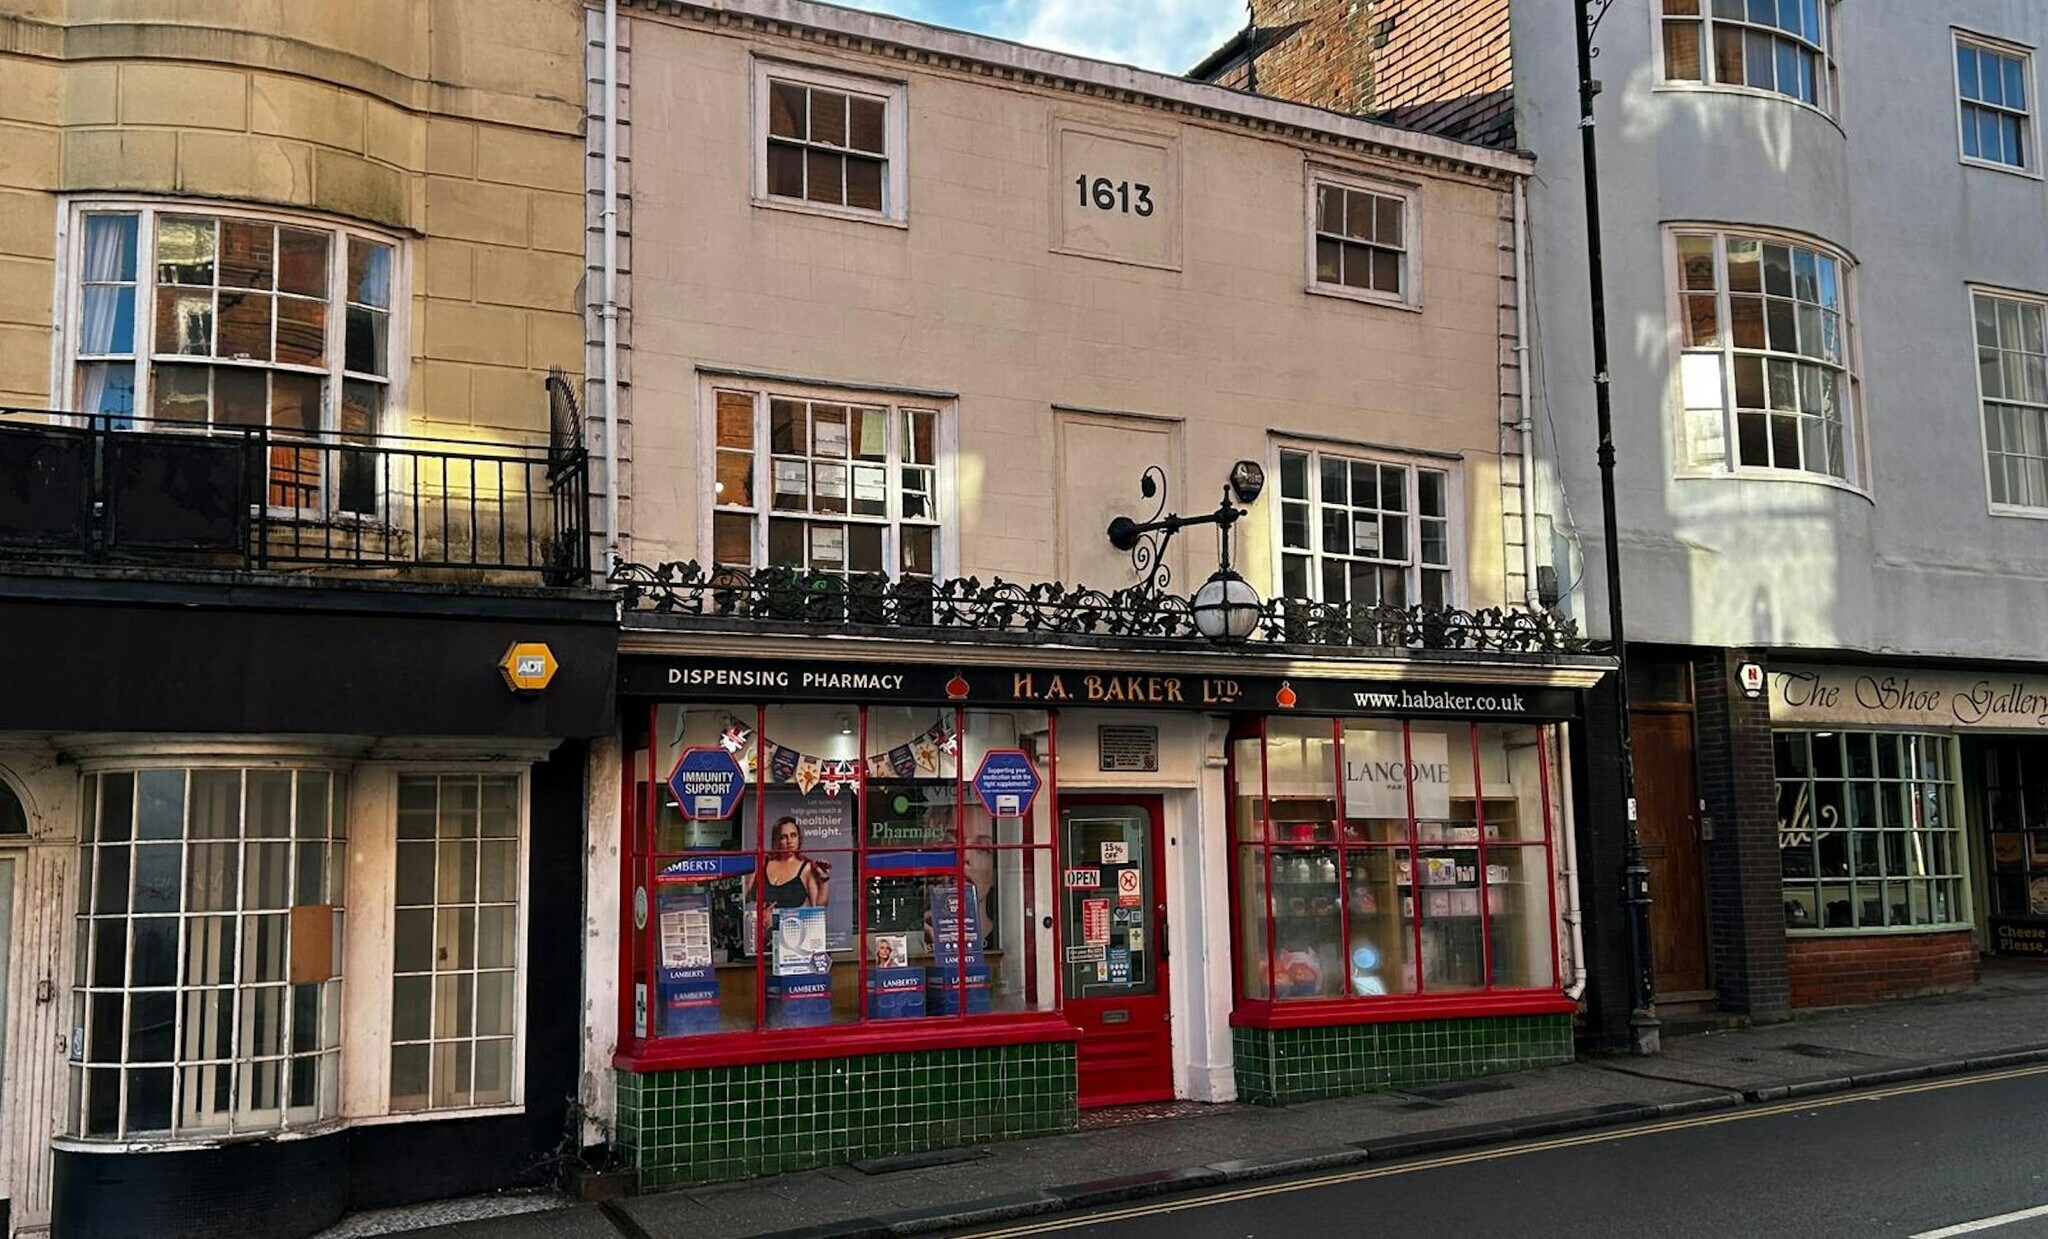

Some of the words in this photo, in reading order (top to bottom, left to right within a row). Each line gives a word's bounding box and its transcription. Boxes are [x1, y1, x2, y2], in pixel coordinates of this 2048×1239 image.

[1075, 173, 1154, 217] 1613
[517, 660, 544, 673] ADT
[667, 668, 789, 687] DISPENSING
[802, 672, 904, 690] PHARMACY
[1083, 674, 1185, 702] BAKER
[1774, 671, 1840, 708] The
[1854, 675, 1941, 711] Shoe
[1353, 689, 1526, 712] www.habaker.co.uk
[682, 771, 735, 783] IMMUNITY
[685, 783, 732, 795] SUPPORT
[795, 815, 842, 826] healthier
[803, 827, 842, 838] weight.
[871, 822, 945, 842] Pharmacy
[1104, 843, 1123, 854] 15%
[1067, 871, 1098, 885] OPEN
[1998, 925, 2047, 938] Cheese
[670, 970, 706, 979] LAMBERTS
[788, 984, 826, 994] LAMBERTS
[883, 978, 918, 988] LAMBERTS
[673, 991, 714, 1001] LAMBERTS
